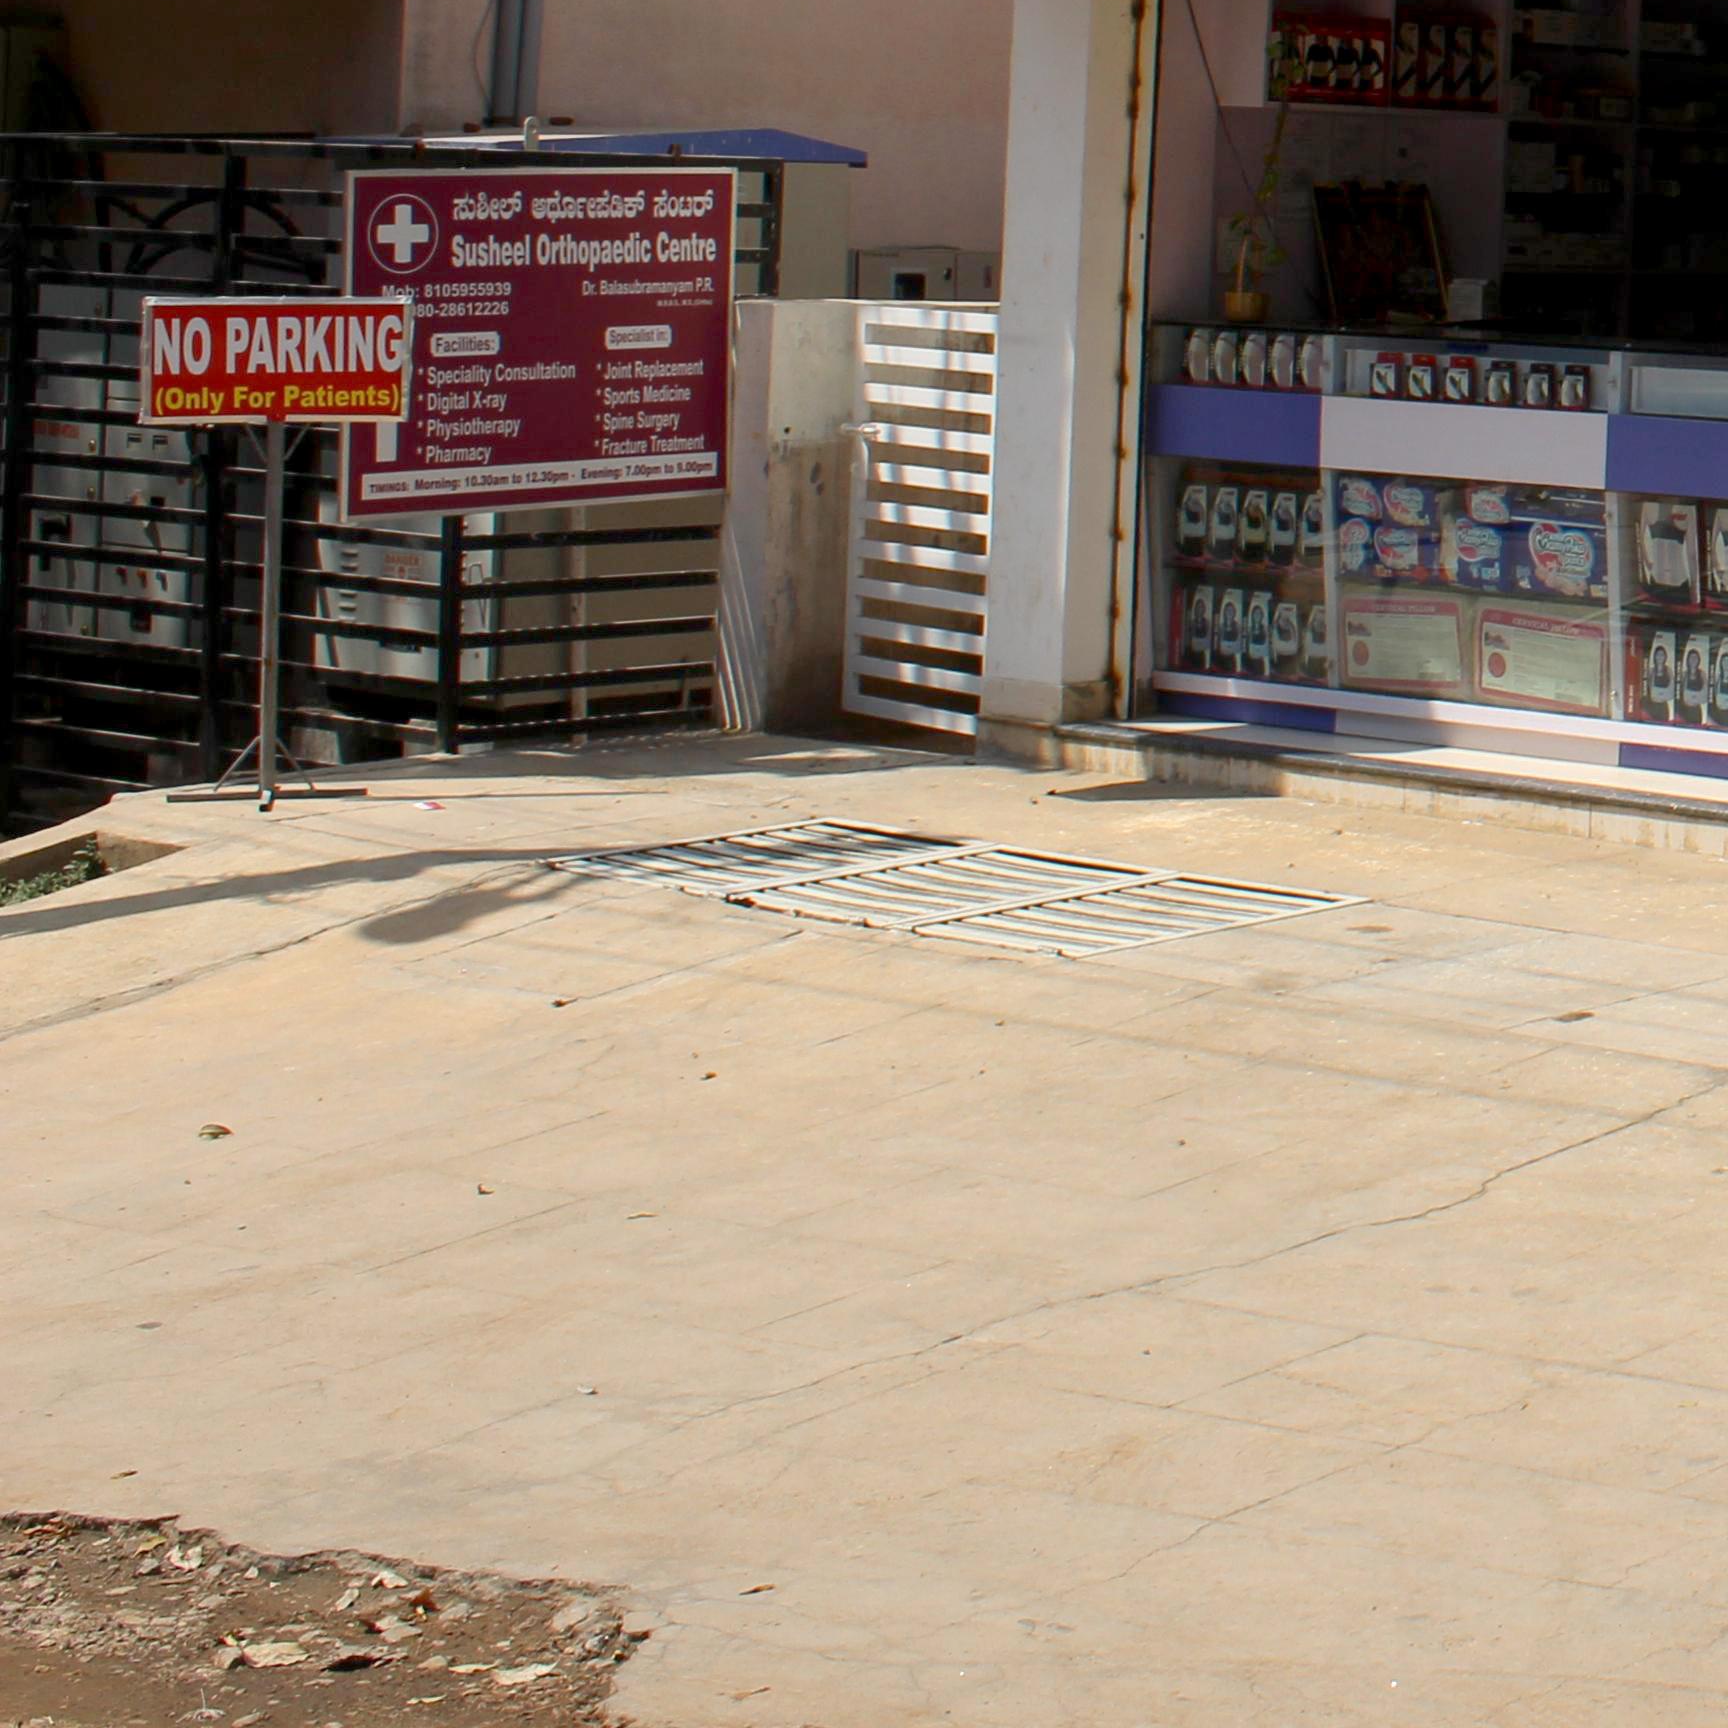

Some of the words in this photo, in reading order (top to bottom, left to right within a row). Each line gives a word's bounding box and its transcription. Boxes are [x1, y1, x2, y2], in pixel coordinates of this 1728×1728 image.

[452, 234, 531, 267] Susheel
[537, 232, 651, 272] Orthopaedic
[656, 231, 717, 263] Centre
[424, 282, 512, 298] 8105955939
[582, 280, 597, 296] Dr.
[154, 317, 212, 375] NO
[226, 315, 403, 374] PARKING
[435, 336, 496, 353] Facilities:
[427, 366, 492, 387] Speciality
[495, 362, 576, 382] Consultation
[604, 361, 632, 380] Joint
[634, 358, 704, 381] Replacement
[155, 387, 225, 415] (Only
[234, 386, 276, 408] For
[283, 384, 399, 411] Patients)
[427, 392, 469, 414] Digital
[473, 390, 507, 412] X-ray
[604, 387, 640, 408] Sports
[643, 384, 691, 403] Medicine
[426, 417, 520, 441] Physiotherapy
[603, 412, 634, 433] Spine
[637, 411, 680, 431] Surgery
[426, 445, 492, 464] Pharmacy
[602, 438, 648, 455] Fracture
[650, 434, 704, 453] Treatment
